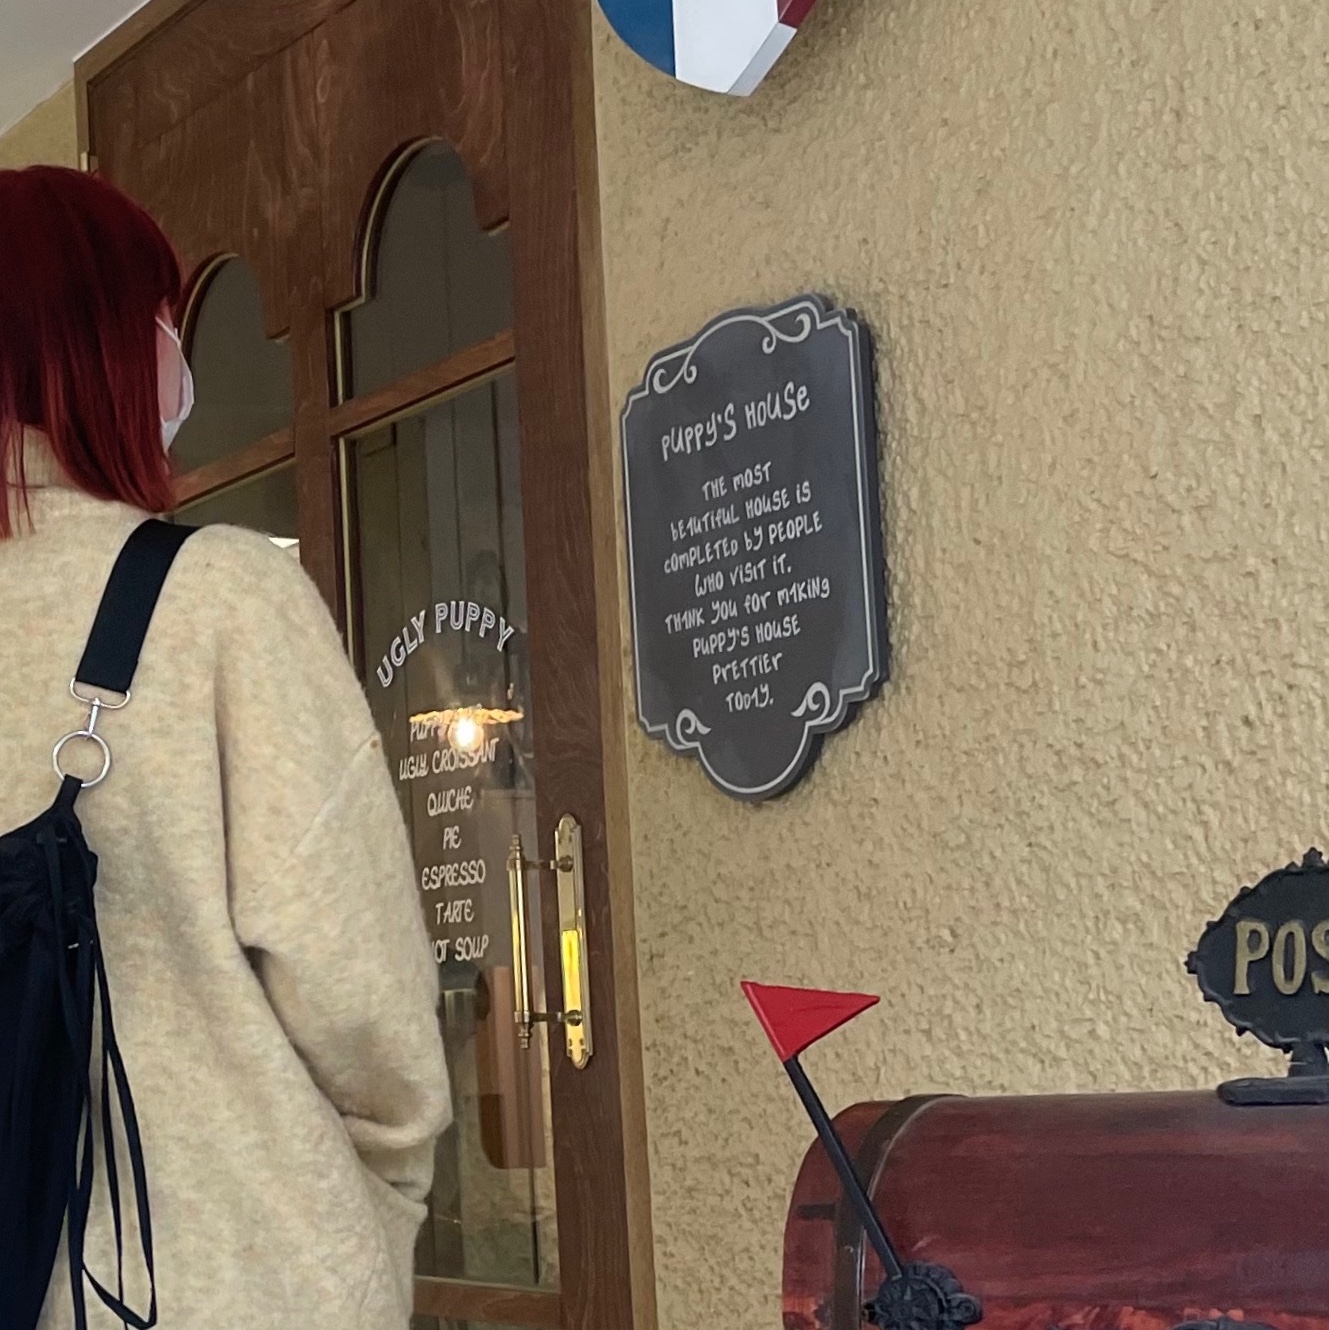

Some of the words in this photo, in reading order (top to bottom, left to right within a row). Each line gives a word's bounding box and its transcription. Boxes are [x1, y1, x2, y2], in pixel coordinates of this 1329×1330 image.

[661, 402, 737, 461] PUPPY'S
[701, 476, 727, 501] THE
[745, 488, 790, 519] HOUSE
[768, 511, 822, 544] PEOPLE
[694, 571, 724, 597] WHO
[664, 607, 705, 634] THANK
[711, 599, 738, 625] YOU
[376, 609, 426, 688] UGLY
[435, 601, 515, 652] PUPPY
[692, 625, 750, 658] PUPPY'S
[755, 613, 801, 644] HOUSE
[398, 752, 429, 781] UGLY
[432, 737, 500, 774] CROISSANT
[427, 786, 474, 817] QUICHE
[443, 825, 462, 850] PIE
[422, 859, 486, 890] ESPRESSO
[435, 899, 475, 925] TARTE
[432, 939, 450, 963] OT
[455, 934, 490, 961] SOUP
